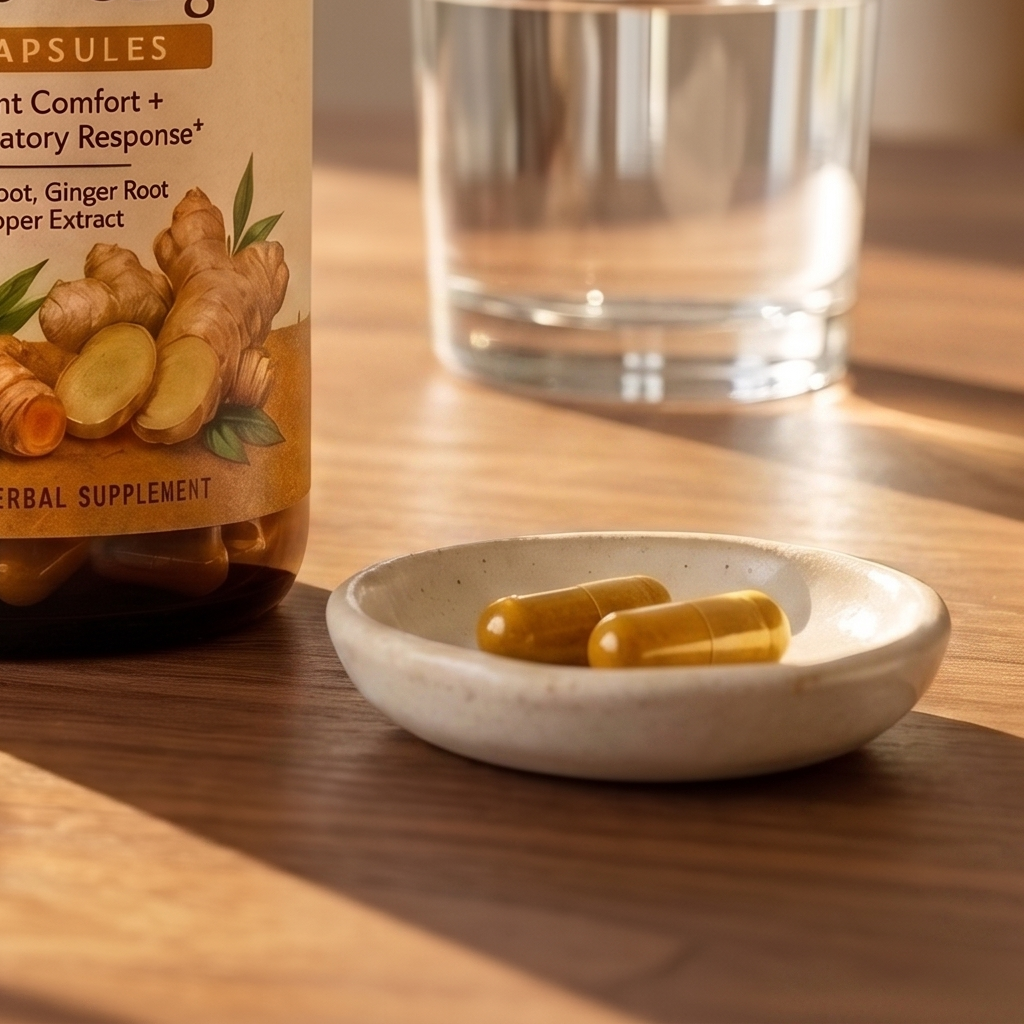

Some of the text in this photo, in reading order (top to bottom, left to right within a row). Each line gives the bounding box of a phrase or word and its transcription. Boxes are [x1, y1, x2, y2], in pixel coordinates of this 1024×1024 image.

[30, 87, 141, 115] Comfort
[148, 92, 164, 110] +
[44, 181, 119, 207] Ginger
[124, 179, 169, 201] Root
[49, 208, 125, 230] Extract
[78, 477, 212, 509] SUPPLEMENT
